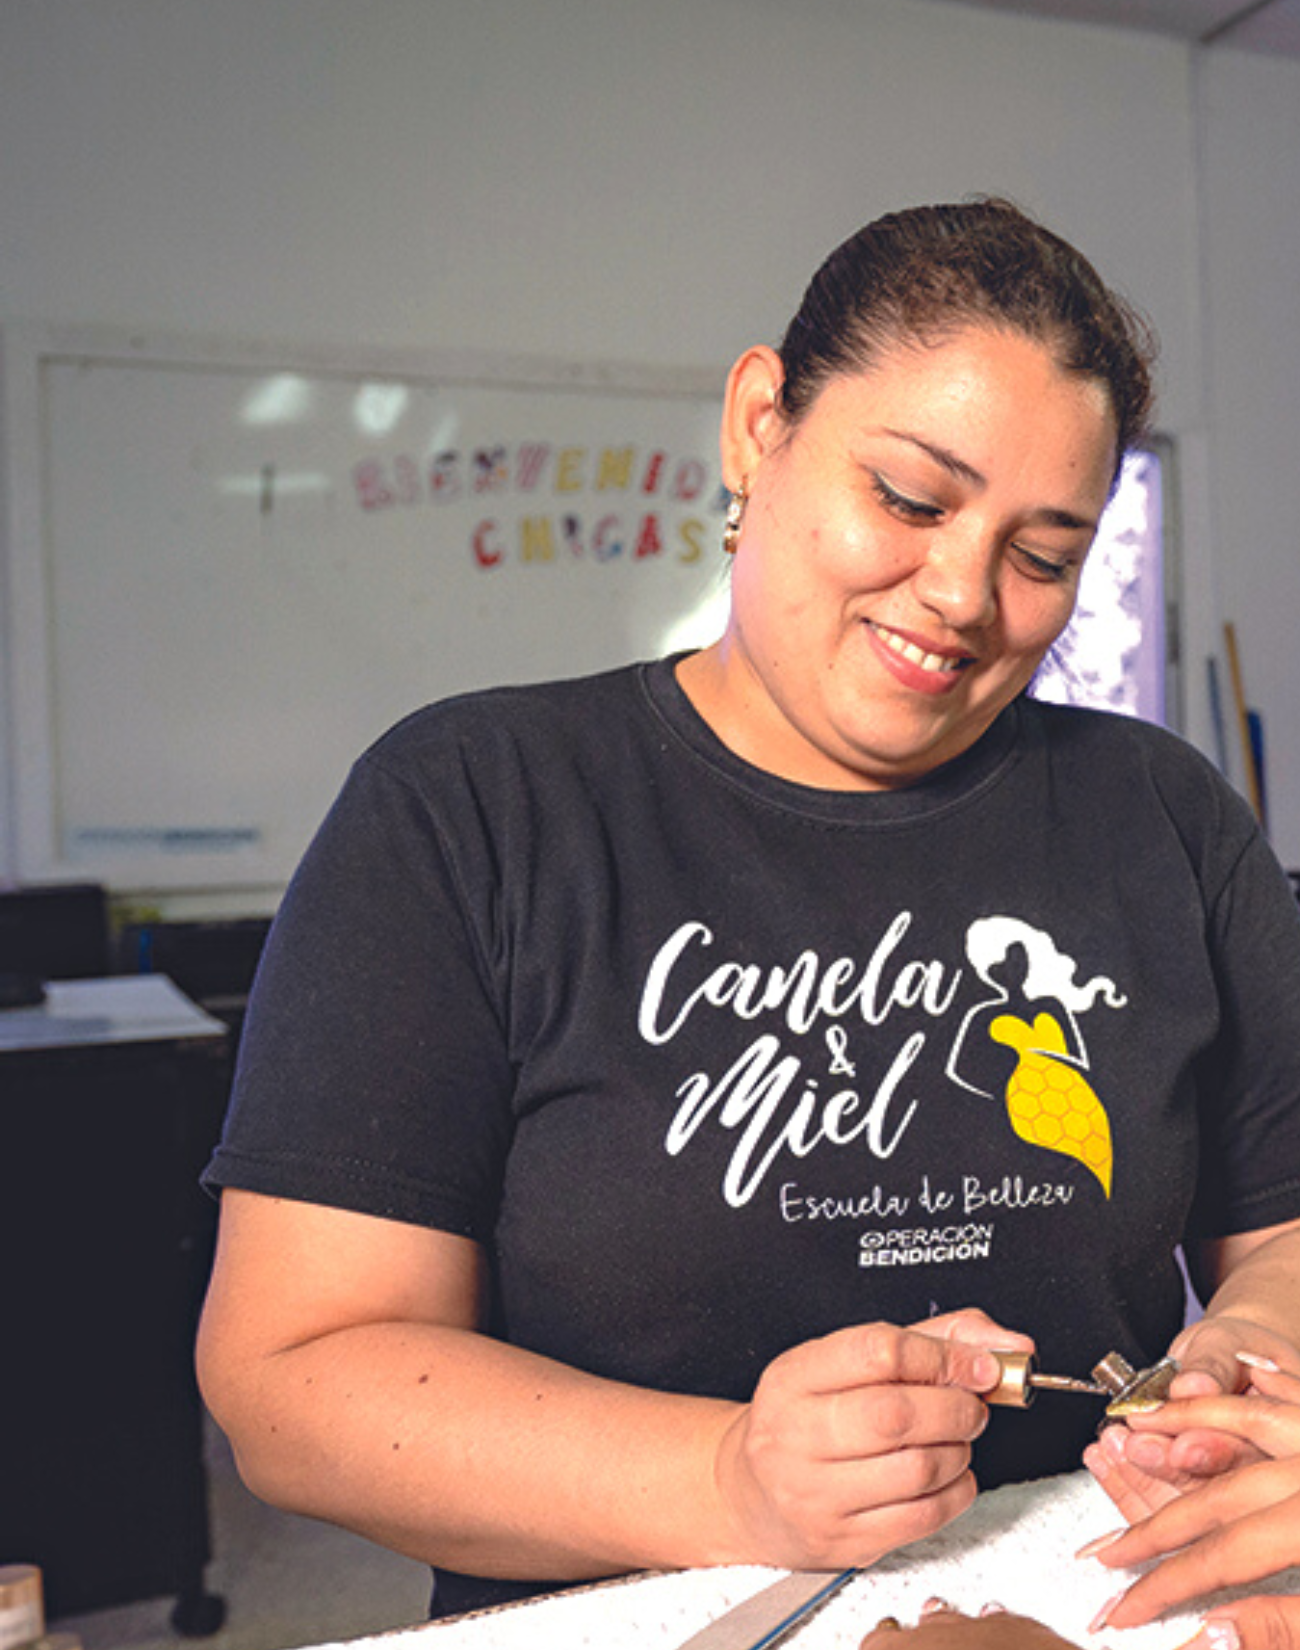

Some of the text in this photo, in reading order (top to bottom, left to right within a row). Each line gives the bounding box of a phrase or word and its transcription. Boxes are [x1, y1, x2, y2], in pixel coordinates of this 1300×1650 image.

[472, 512, 705, 569] CHICAS
[638, 910, 962, 1046] Canela
[825, 1024, 855, 1077] &
[664, 1031, 926, 1208] Miel
[779, 1174, 1075, 1222] Escuela de Belleza
